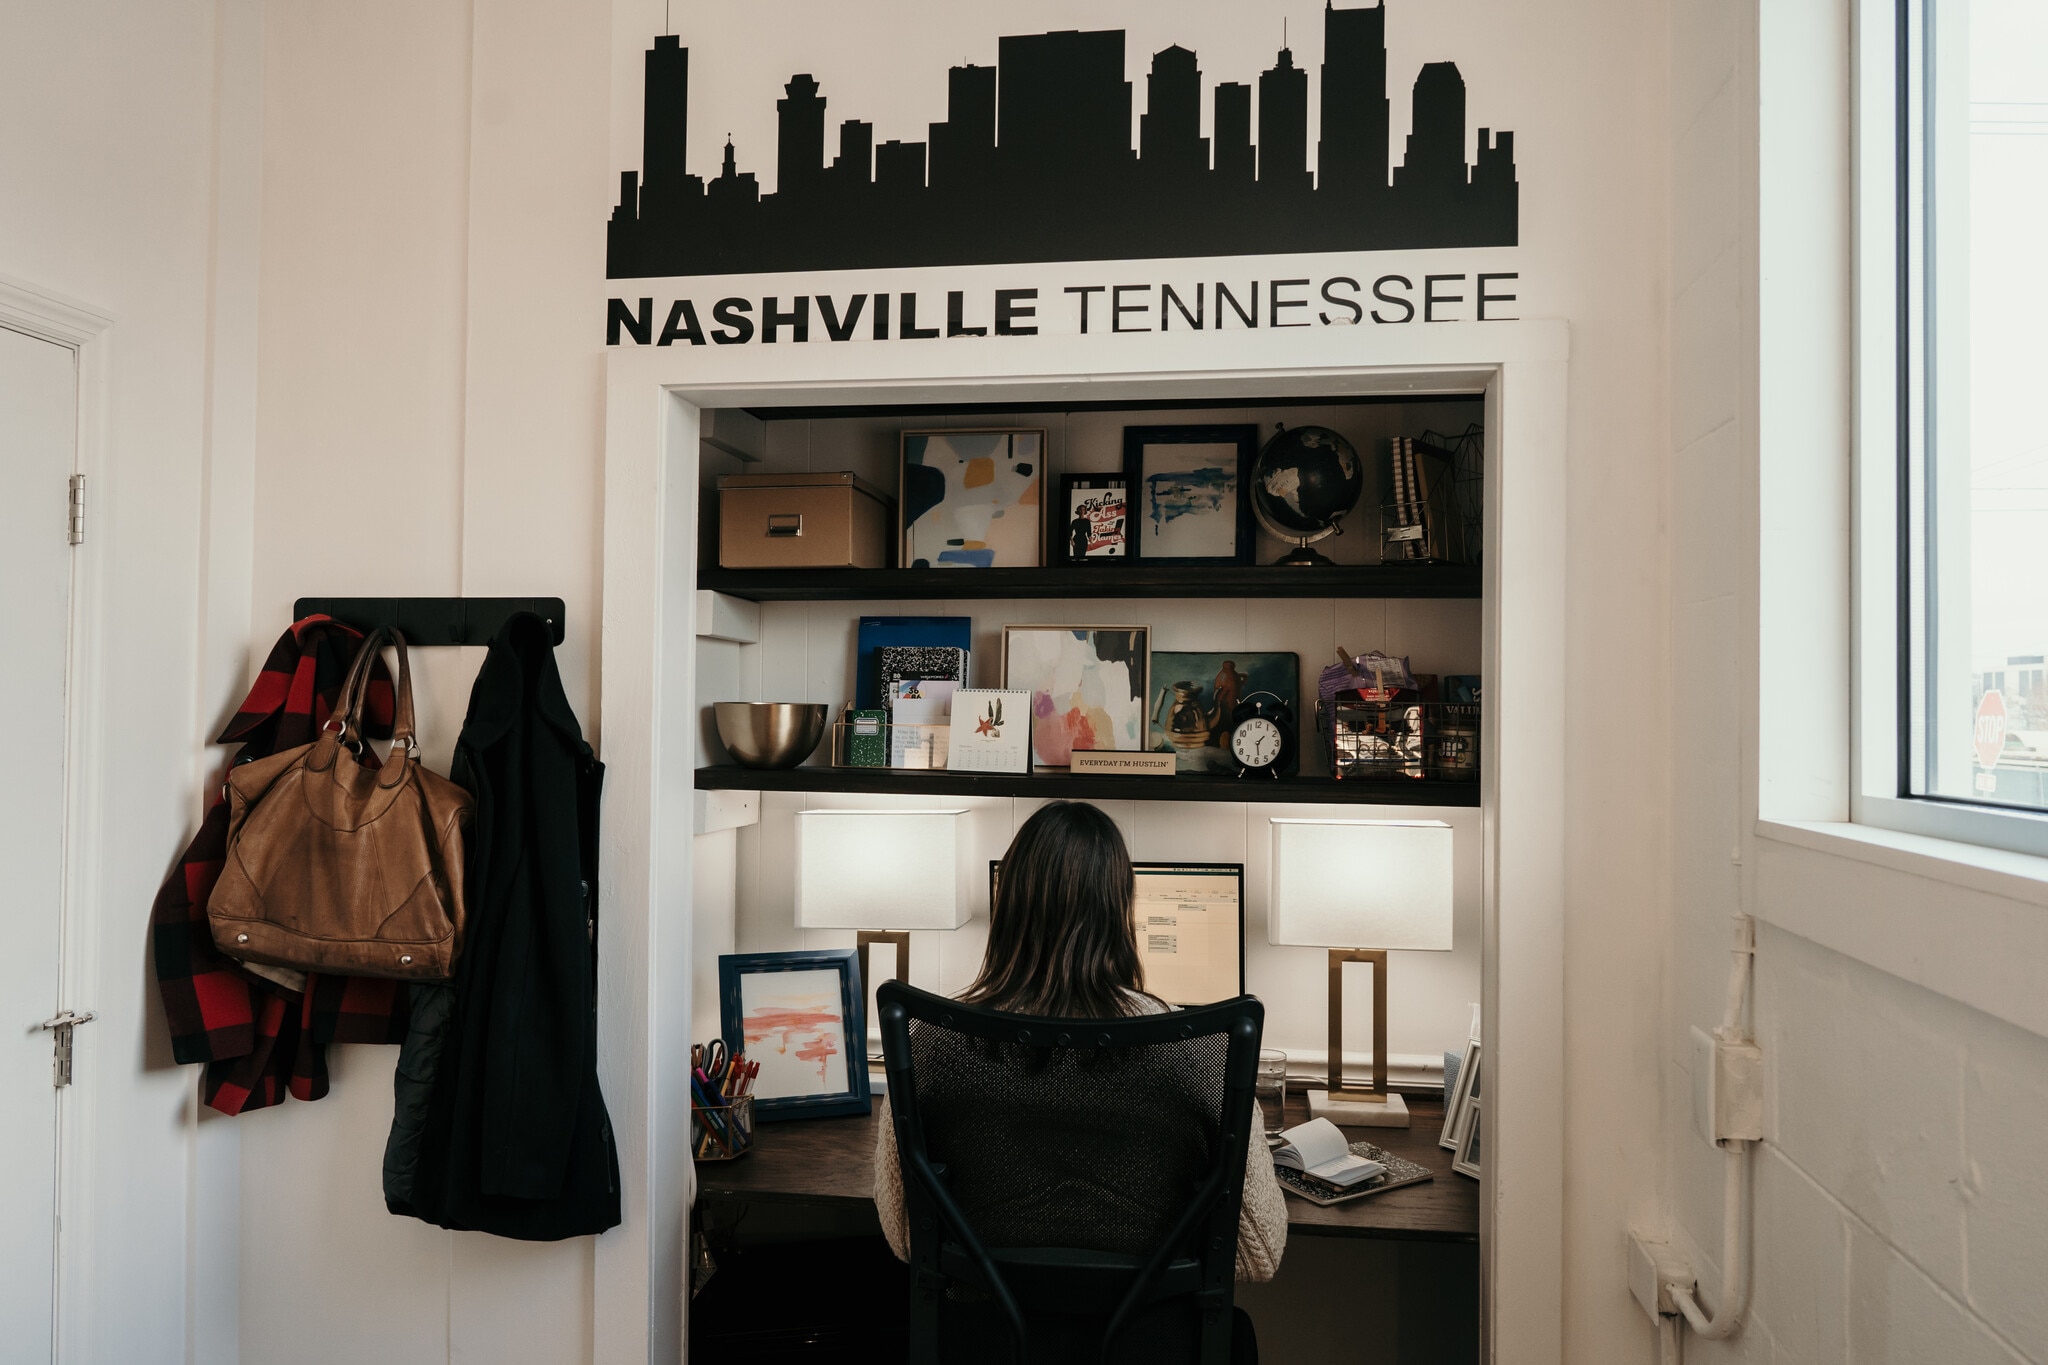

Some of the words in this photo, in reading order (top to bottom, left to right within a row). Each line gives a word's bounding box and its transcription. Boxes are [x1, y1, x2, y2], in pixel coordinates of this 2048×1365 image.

[606, 288, 1039, 347] NASHVILLE
[1063, 272, 1520, 335] TENNESSEE
[1084, 492, 1123, 511] Kicking
[1089, 506, 1117, 521] Ass
[1092, 523, 1121, 535] Taking
[1255, 721, 1262, 729] 12
[1266, 723, 1269, 731] 1
[1977, 715, 2004, 744] STOP
[1239, 730, 1247, 738] 10
[1272, 730, 1277, 738] 2
[1236, 738, 1242, 746] 9
[1274, 739, 1280, 747] 3
[1270, 748, 1276, 756] 4
[1254, 757, 1259, 765] 6
[1263, 755, 1269, 763] 5
[1079, 759, 1118, 767] EVERYDAY
[1132, 760, 1169, 768] HUSTLIN'
